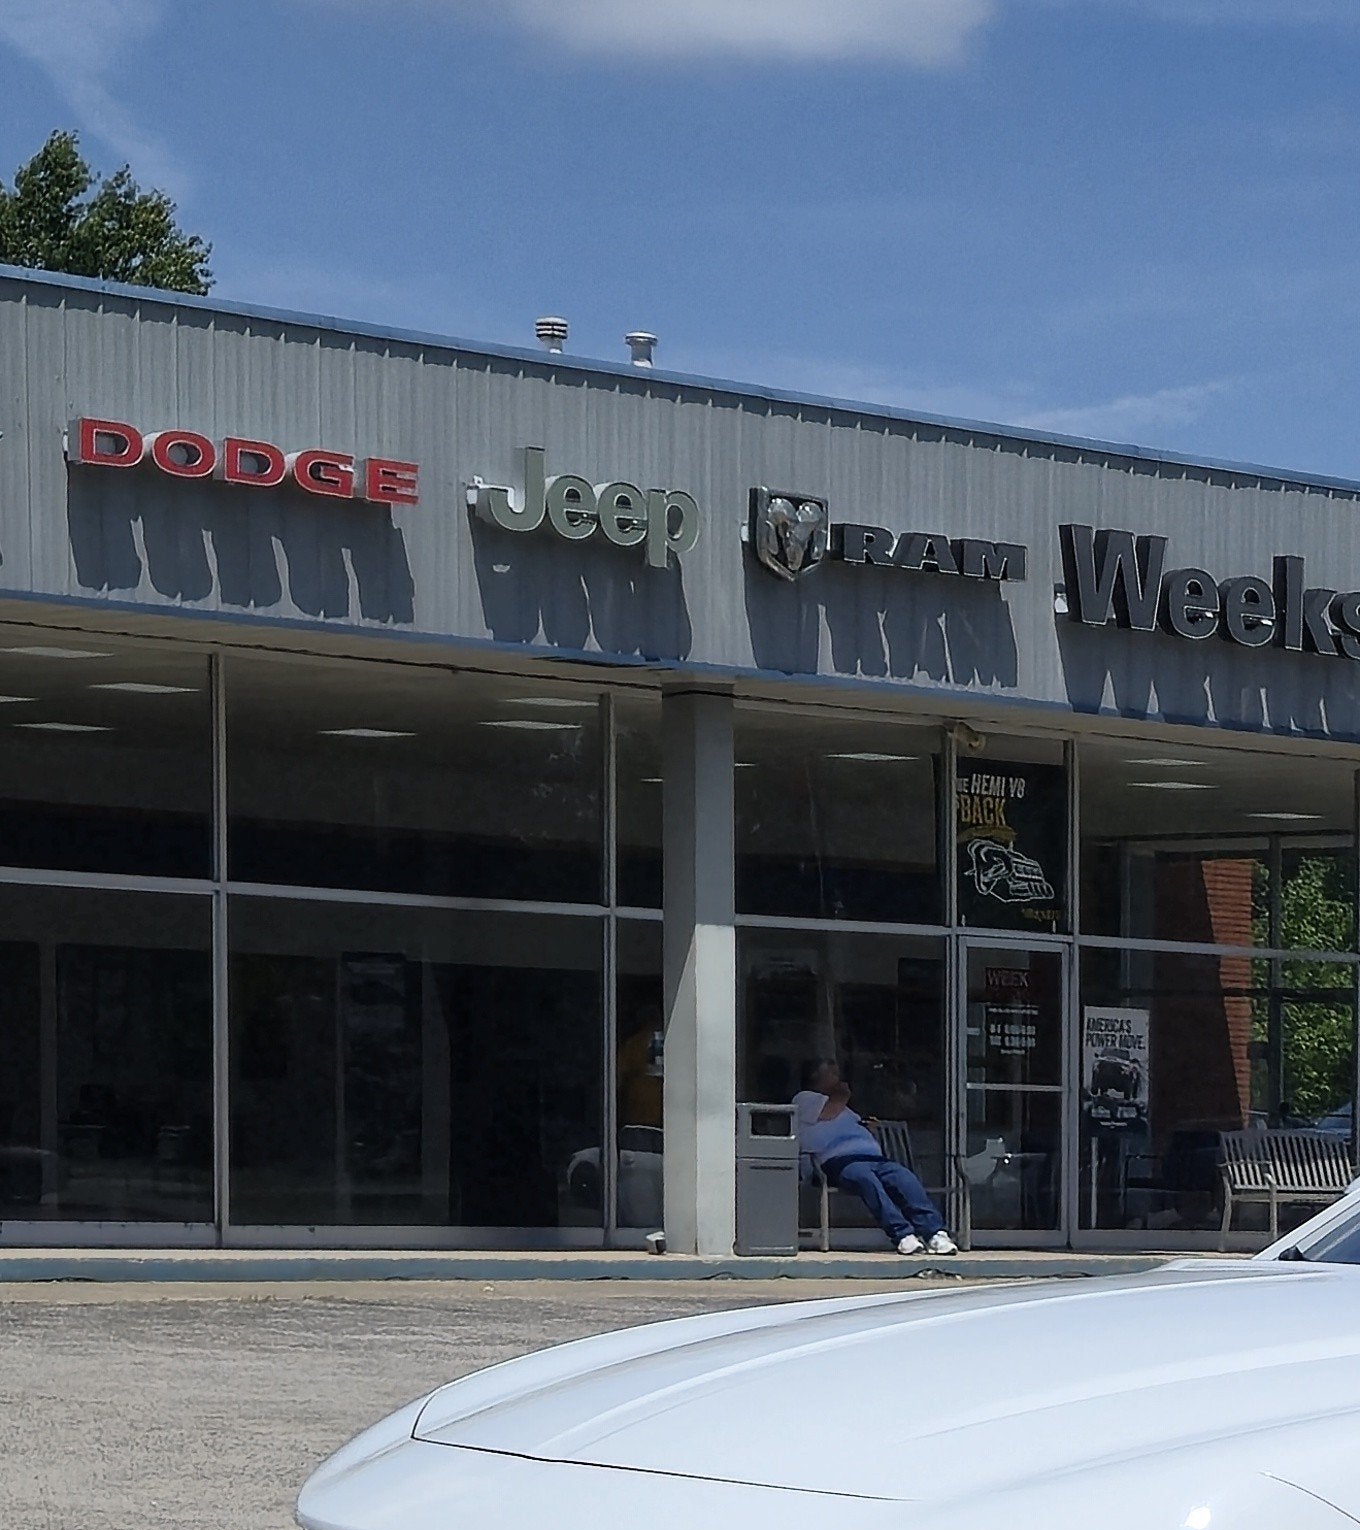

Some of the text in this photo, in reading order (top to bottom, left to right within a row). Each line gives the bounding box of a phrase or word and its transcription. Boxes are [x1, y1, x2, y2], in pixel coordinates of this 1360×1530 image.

[74, 417, 419, 504] DODGE
[486, 446, 700, 568] Jeep
[831, 523, 1027, 581] RAM
[960, 794, 1007, 827] BACK
[971, 773, 1006, 797] HEMI
[1009, 777, 1026, 799] V8
